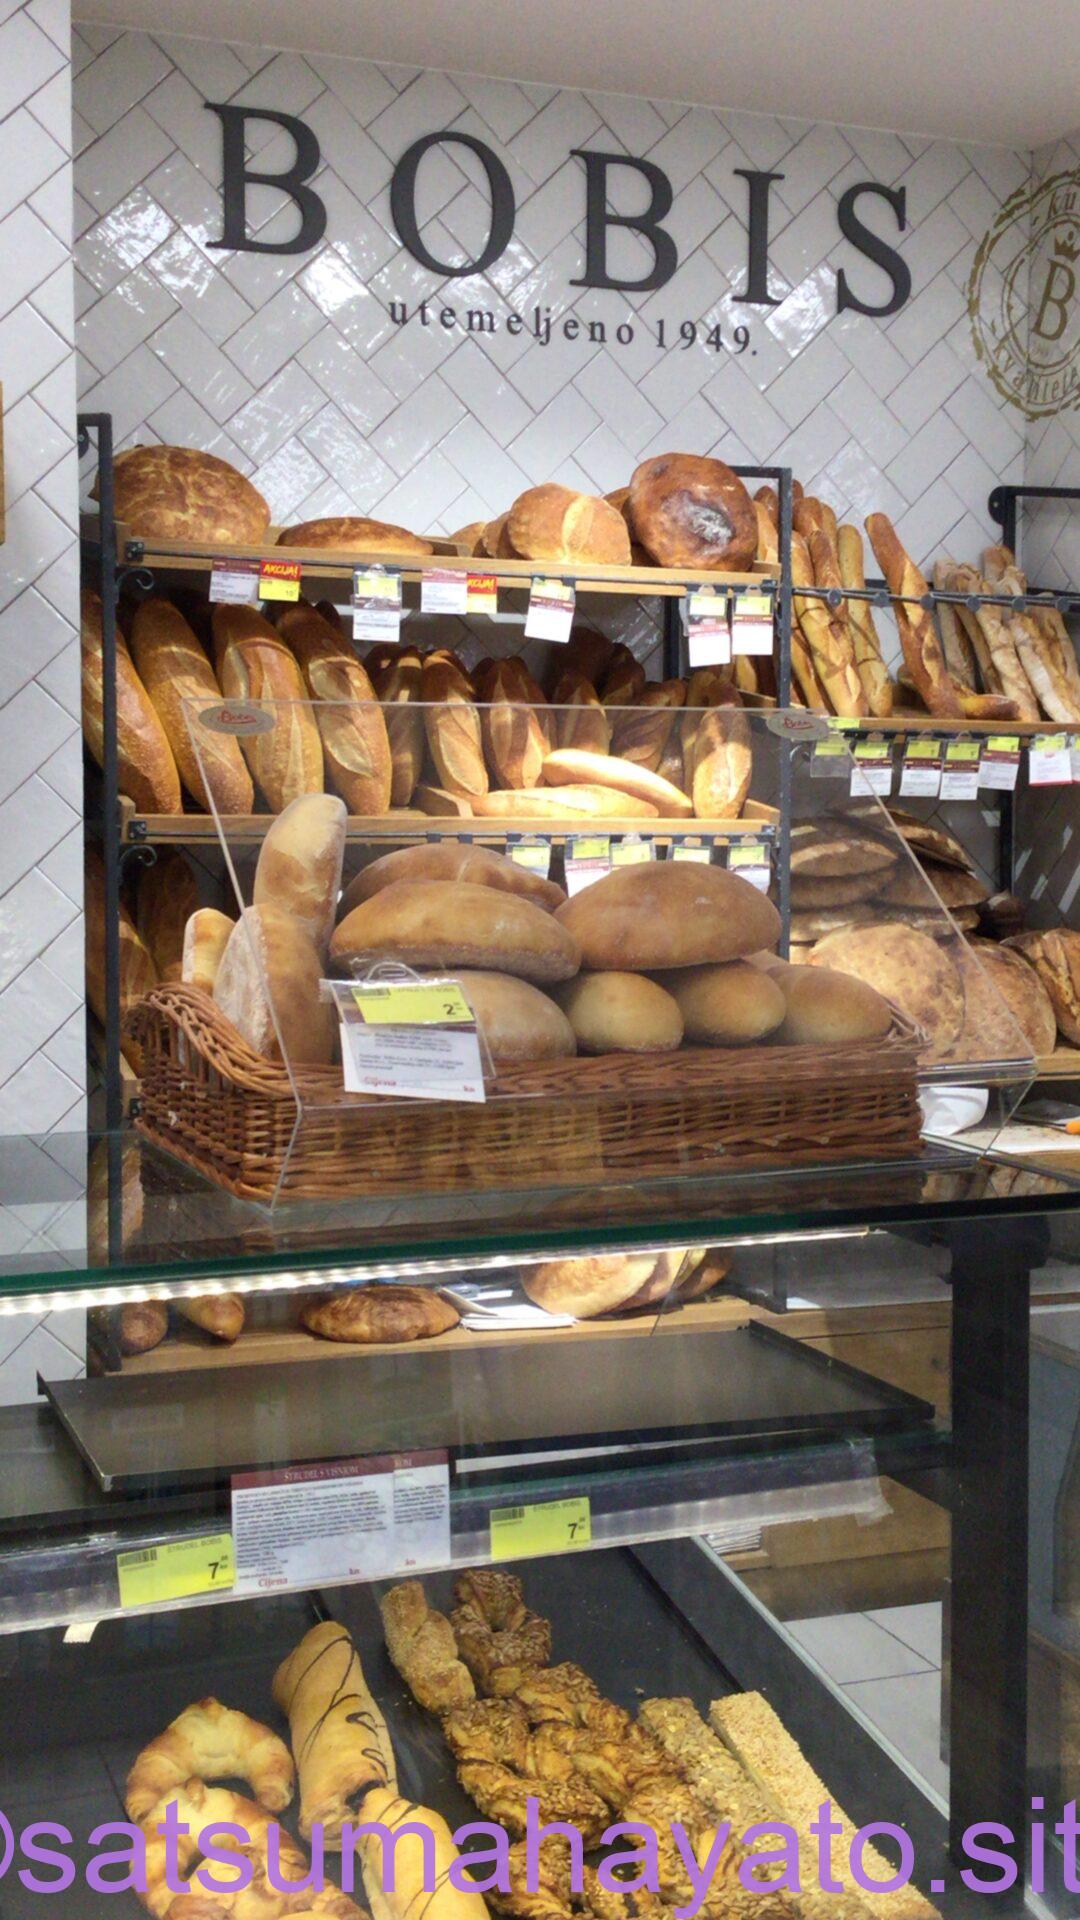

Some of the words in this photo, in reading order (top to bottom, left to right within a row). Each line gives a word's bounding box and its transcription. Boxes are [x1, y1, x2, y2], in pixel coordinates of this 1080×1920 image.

[204, 101, 912, 318] BOBIS
[1032, 258, 1076, 342] B
[389, 299, 634, 347] utemeljeno
[655, 318, 758, 357] 1949.
[263, 563, 299, 579] AKCIJA!
[442, 1002, 457, 1016] 2
[567, 1522, 578, 1540] 7
[207, 1561, 220, 1580] 7
[258, 1576, 288, 1589] Cijena
